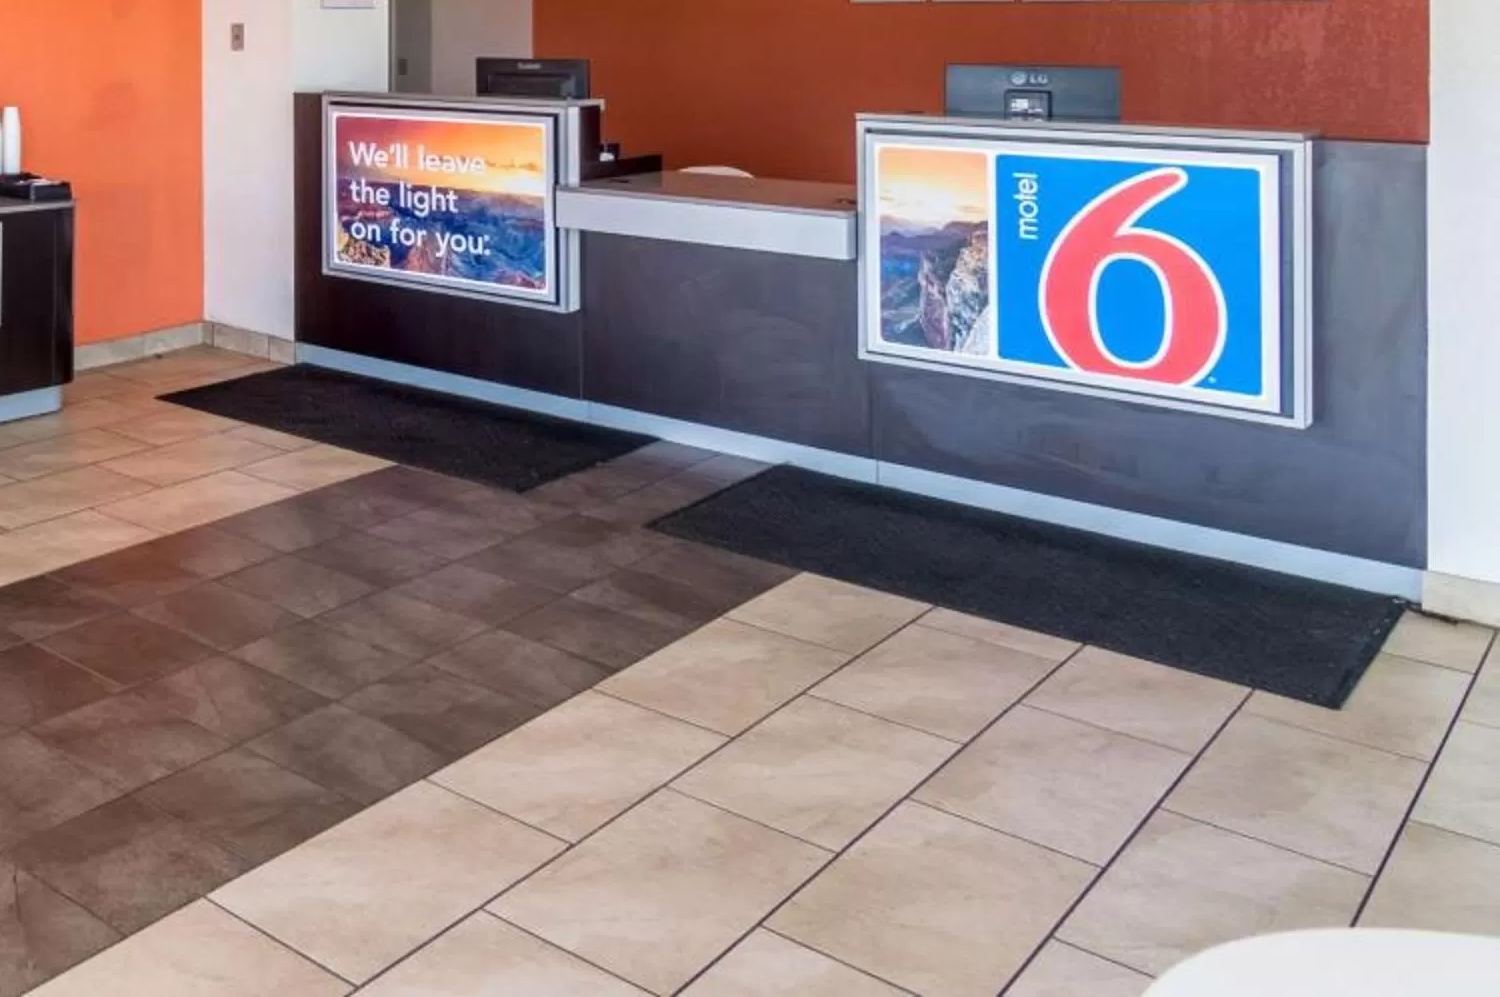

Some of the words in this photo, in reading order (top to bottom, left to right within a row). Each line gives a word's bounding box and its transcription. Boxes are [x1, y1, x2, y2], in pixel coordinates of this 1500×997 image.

[348, 140, 409, 169] We'll
[419, 144, 486, 174] leave
[350, 179, 390, 205] the
[399, 181, 459, 217] light
[1013, 172, 1039, 241] motel
[350, 220, 380, 241] on
[390, 219, 426, 247] for
[1039, 167, 1228, 388] 6
